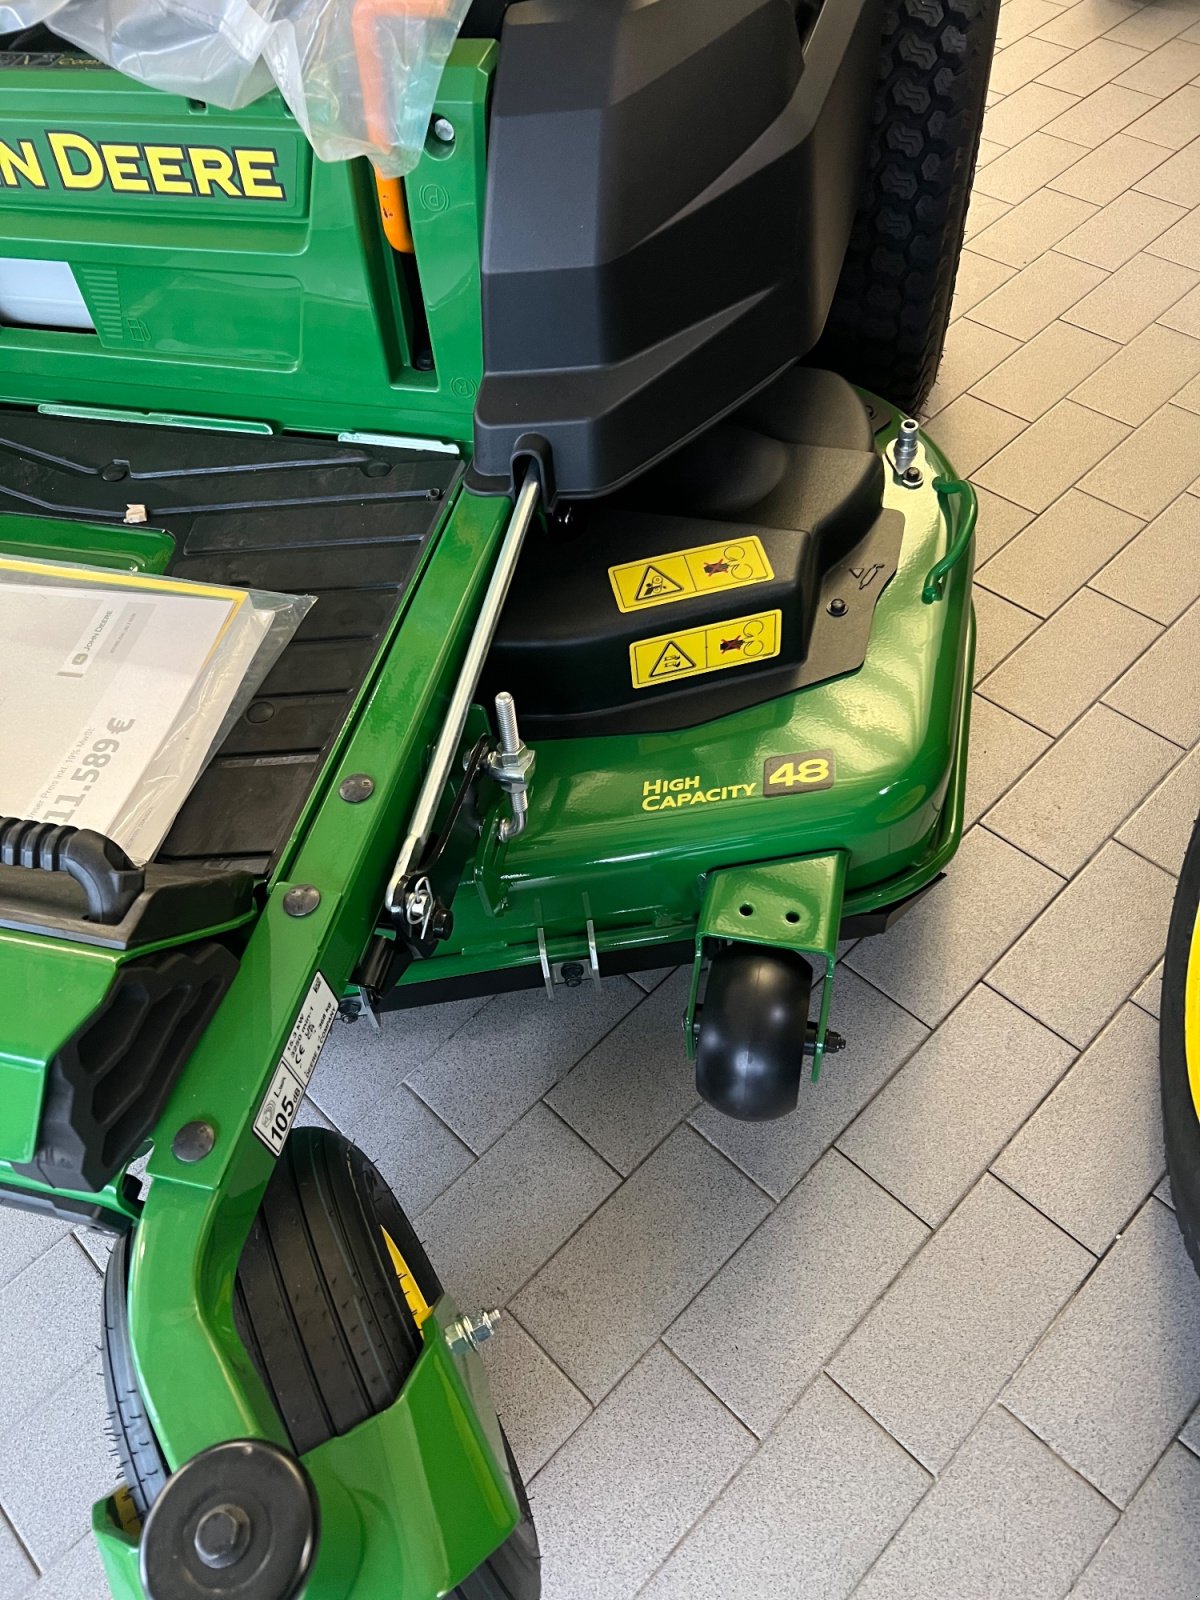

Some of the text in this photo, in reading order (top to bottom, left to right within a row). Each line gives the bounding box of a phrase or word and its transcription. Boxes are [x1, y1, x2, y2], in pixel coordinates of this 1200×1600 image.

[46, 131, 285, 199] DEERE
[84, 610, 112, 652] JOHN DEERE
[42, 738, 120, 822] 11.589
[106, 717, 136, 736] €
[643, 775, 700, 796] HIGH
[769, 758, 829, 787] 48
[642, 783, 757, 811] CAPACITY
[296, 1013, 304, 1030] kW
[295, 1044, 306, 1064] CE
[305, 1051, 317, 1078] DEERE
[319, 1007, 335, 1043] COMPANY
[271, 1088, 300, 1141] 105 dB
